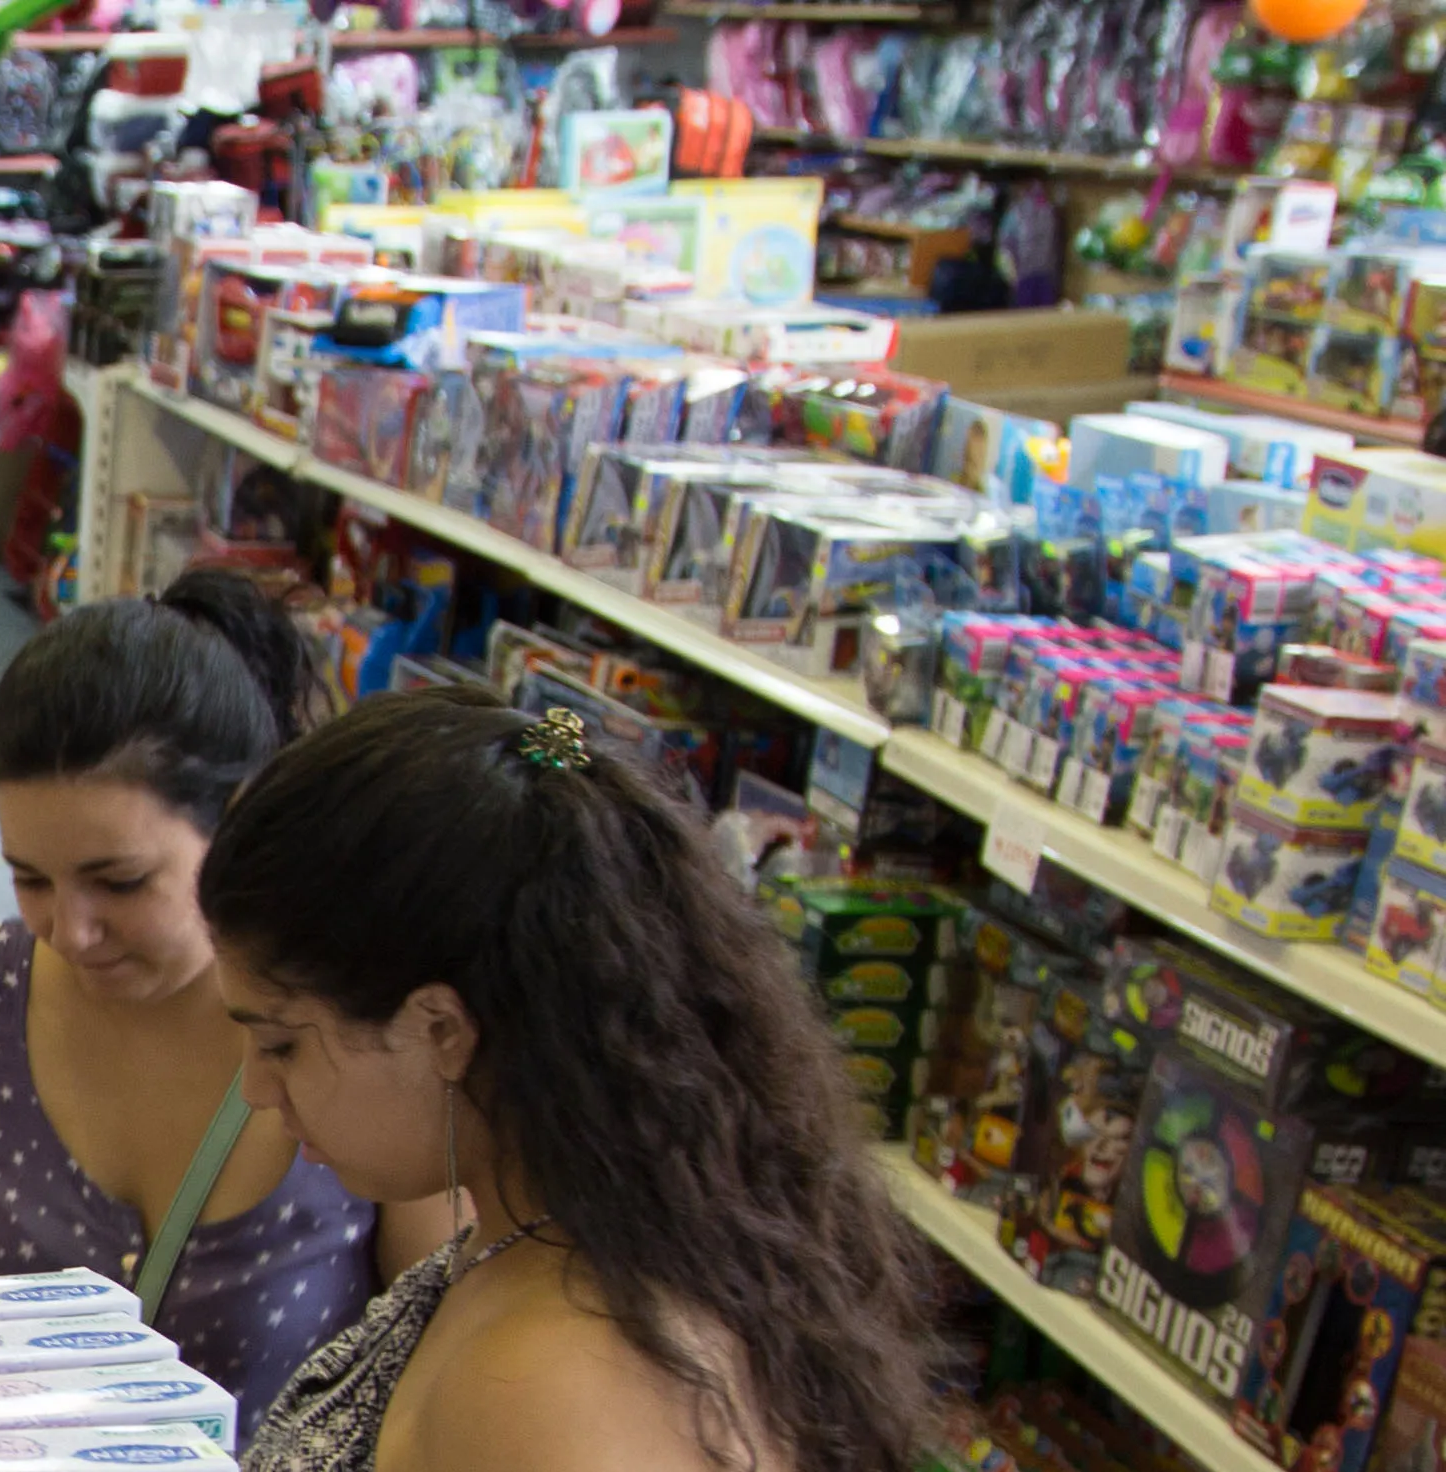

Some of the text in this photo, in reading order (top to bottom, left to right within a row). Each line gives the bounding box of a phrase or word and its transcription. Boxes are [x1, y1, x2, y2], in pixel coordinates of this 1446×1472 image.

[1181, 999, 1272, 1079] SIGNOS
[1099, 1245, 1246, 1398] SIGNOS
[88, 1447, 191, 1462] FROZEN
